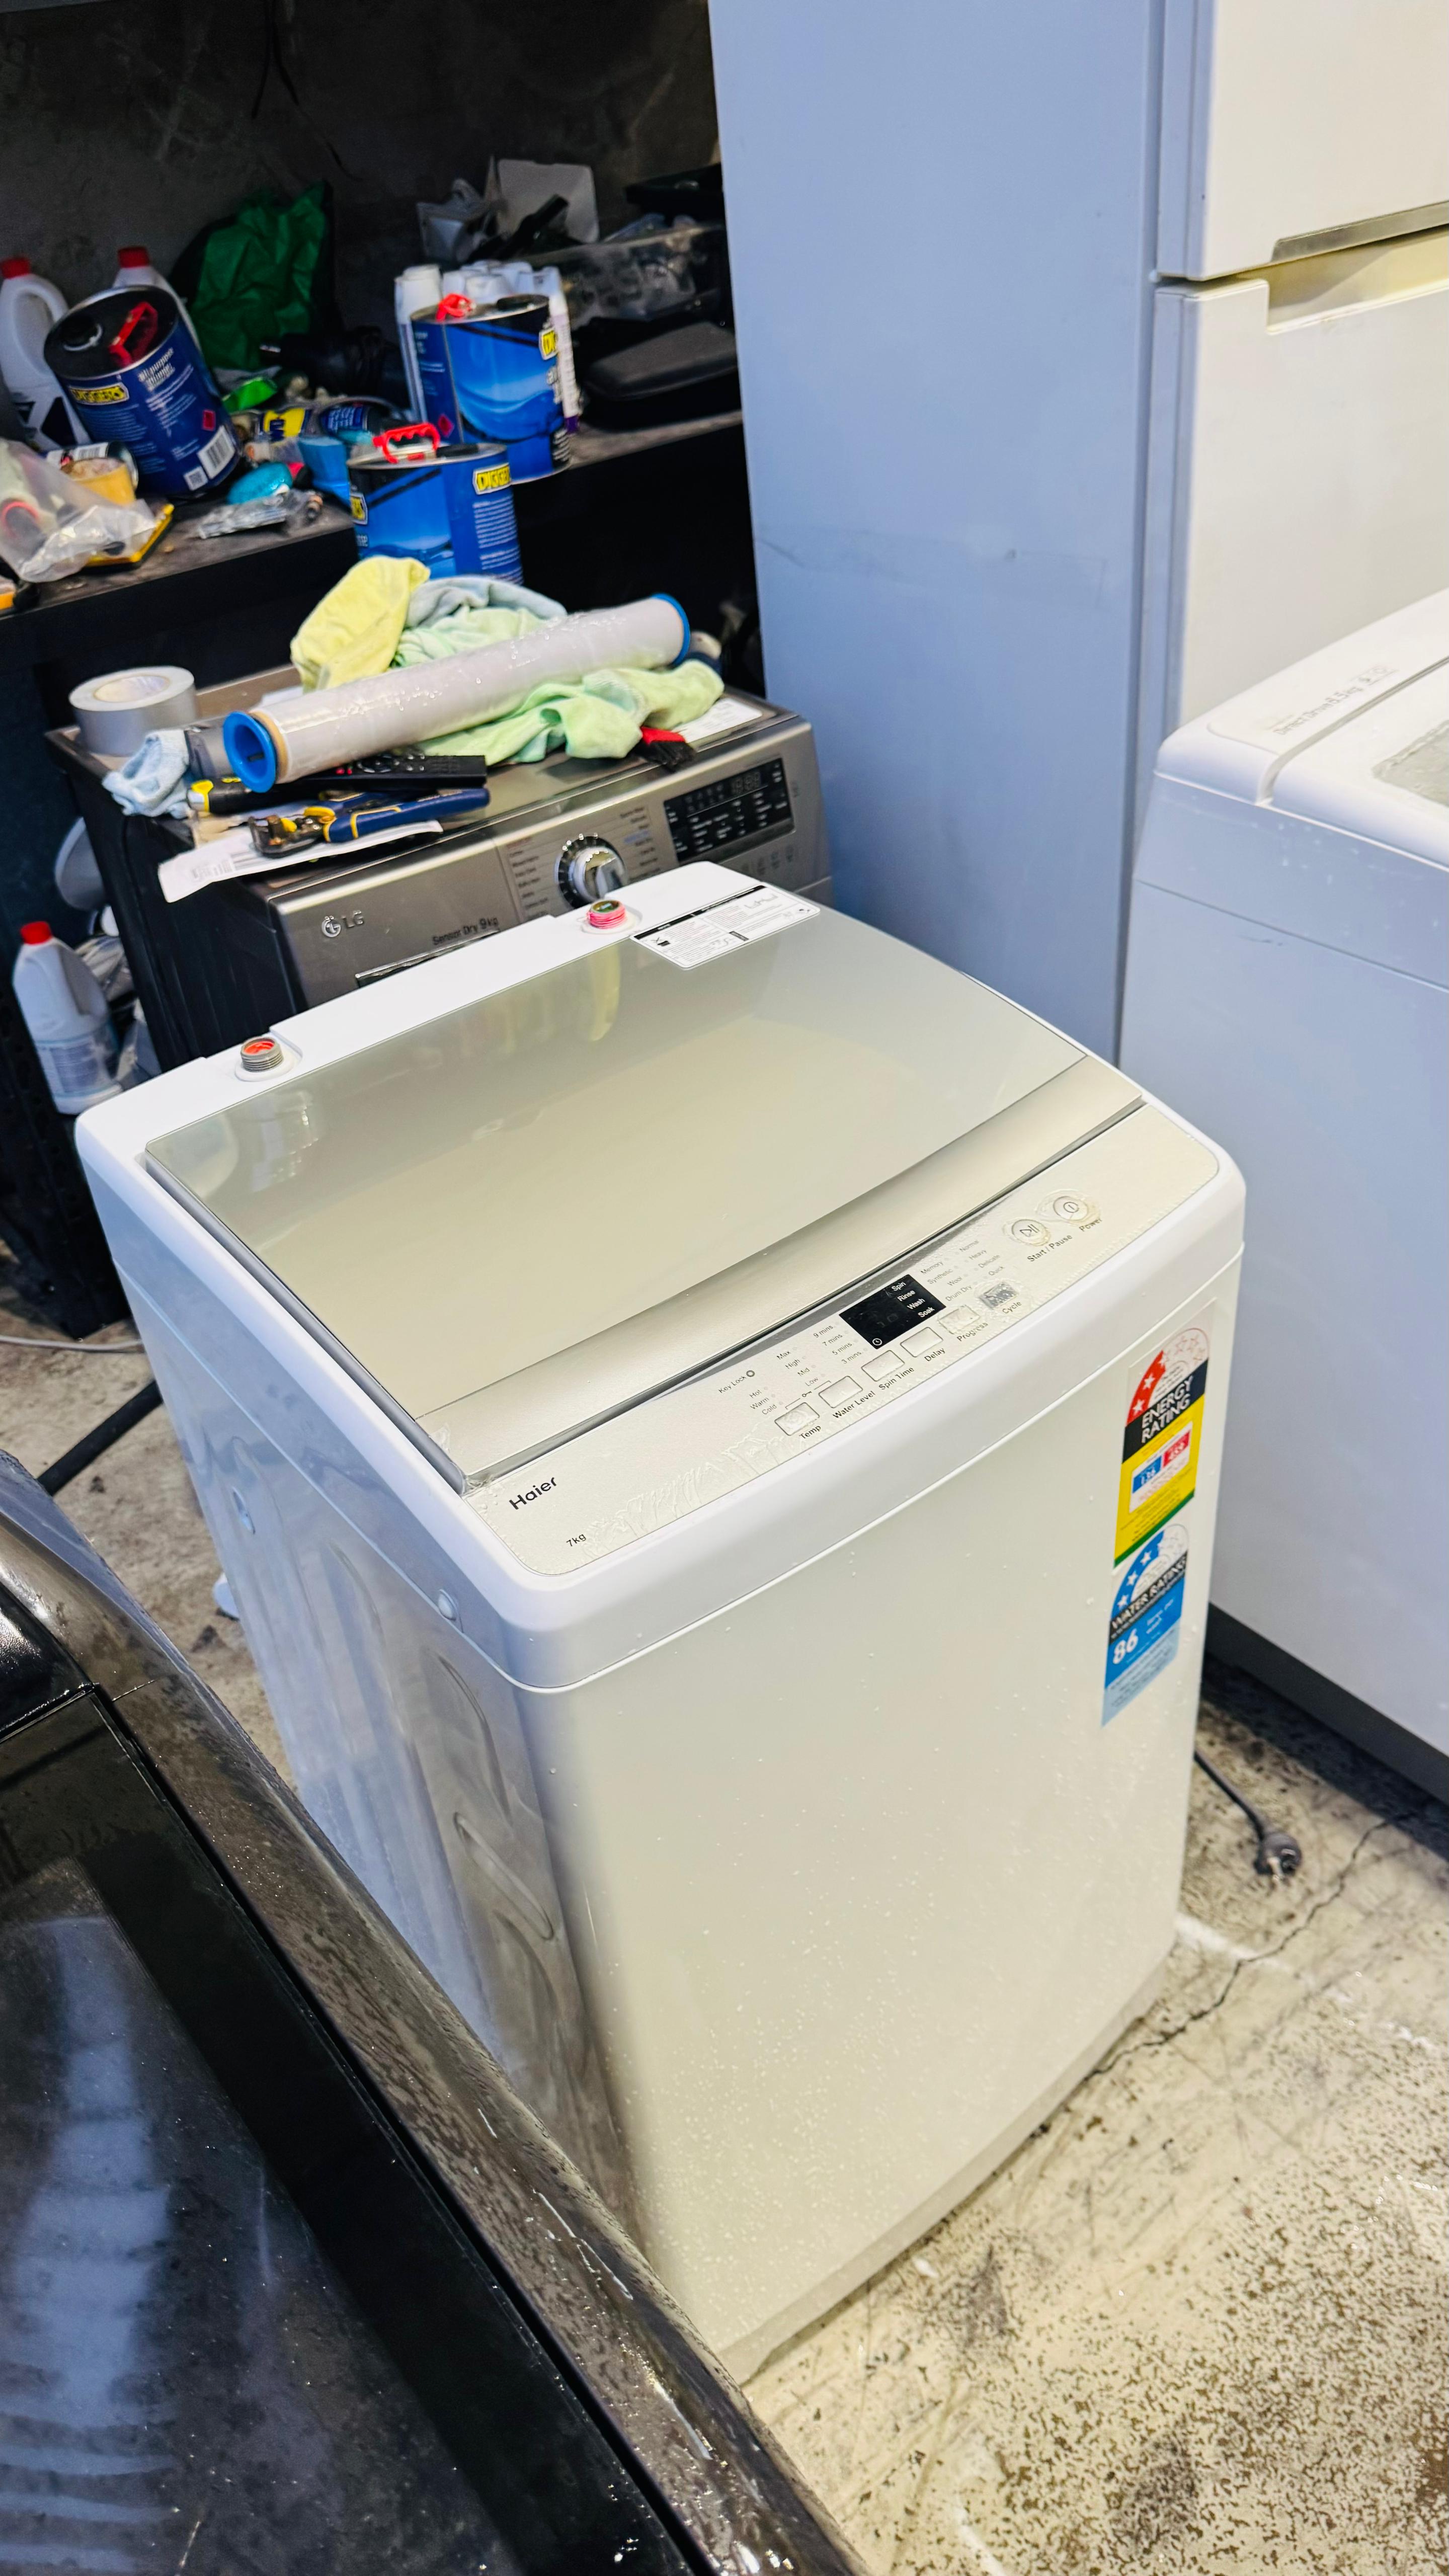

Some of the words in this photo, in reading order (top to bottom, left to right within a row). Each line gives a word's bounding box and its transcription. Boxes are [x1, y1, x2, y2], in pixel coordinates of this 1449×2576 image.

[341, 910, 365, 928] LG
[432, 929, 461, 946] Sensor
[463, 924, 479, 936] Dry
[1079, 1218, 1103, 1232] Power
[959, 1240, 980, 1252] Normal
[1027, 1250, 1047, 1262] Start
[1049, 1234, 1073, 1249] Pause
[969, 1249, 988, 1260] Heavy
[978, 1254, 1000, 1268] Delicate
[921, 1260, 944, 1275] Memory
[988, 1265, 1005, 1276] Quick
[927, 1269, 953, 1284] Synthetic
[947, 1275, 963, 1286] Wool
[891, 1281, 907, 1292] Spin
[945, 1289, 962, 1302] Drum
[961, 1284, 973, 1295] Dry
[897, 1290, 916, 1302] Rinse
[907, 1298, 926, 1310] Wash
[1002, 1301, 1022, 1314] Cycle
[917, 1307, 935, 1318] Soak
[819, 1325, 834, 1335] mins
[957, 1322, 989, 1342] Progress
[828, 1333, 843, 1344] mins
[837, 1342, 853, 1353] mins
[777, 1351, 791, 1361] Max
[847, 1351, 862, 1361] mins
[924, 1347, 946, 1362] Delay
[785, 1358, 801, 1370] High
[797, 1367, 811, 1377] Mid
[878, 1379, 896, 1391] Spin
[896, 1366, 915, 1379] Time
[718, 1384, 732, 1394] Key
[731, 1375, 747, 1387] Lock
[805, 1377, 819, 1387] Low
[749, 1389, 762, 1399] Hot
[750, 1396, 769, 1410] Warm
[832, 1403, 855, 1419] Water
[855, 1391, 876, 1406] Level
[1142, 1375, 1194, 1429] ENERGY
[762, 1404, 777, 1415] Cold
[1141, 1393, 1191, 1443] RATING
[799, 1425, 822, 1440] Temp
[509, 1477, 557, 1510] Haier
[566, 1534, 587, 1547] 7kg
[1112, 1628, 1139, 1665] 86
